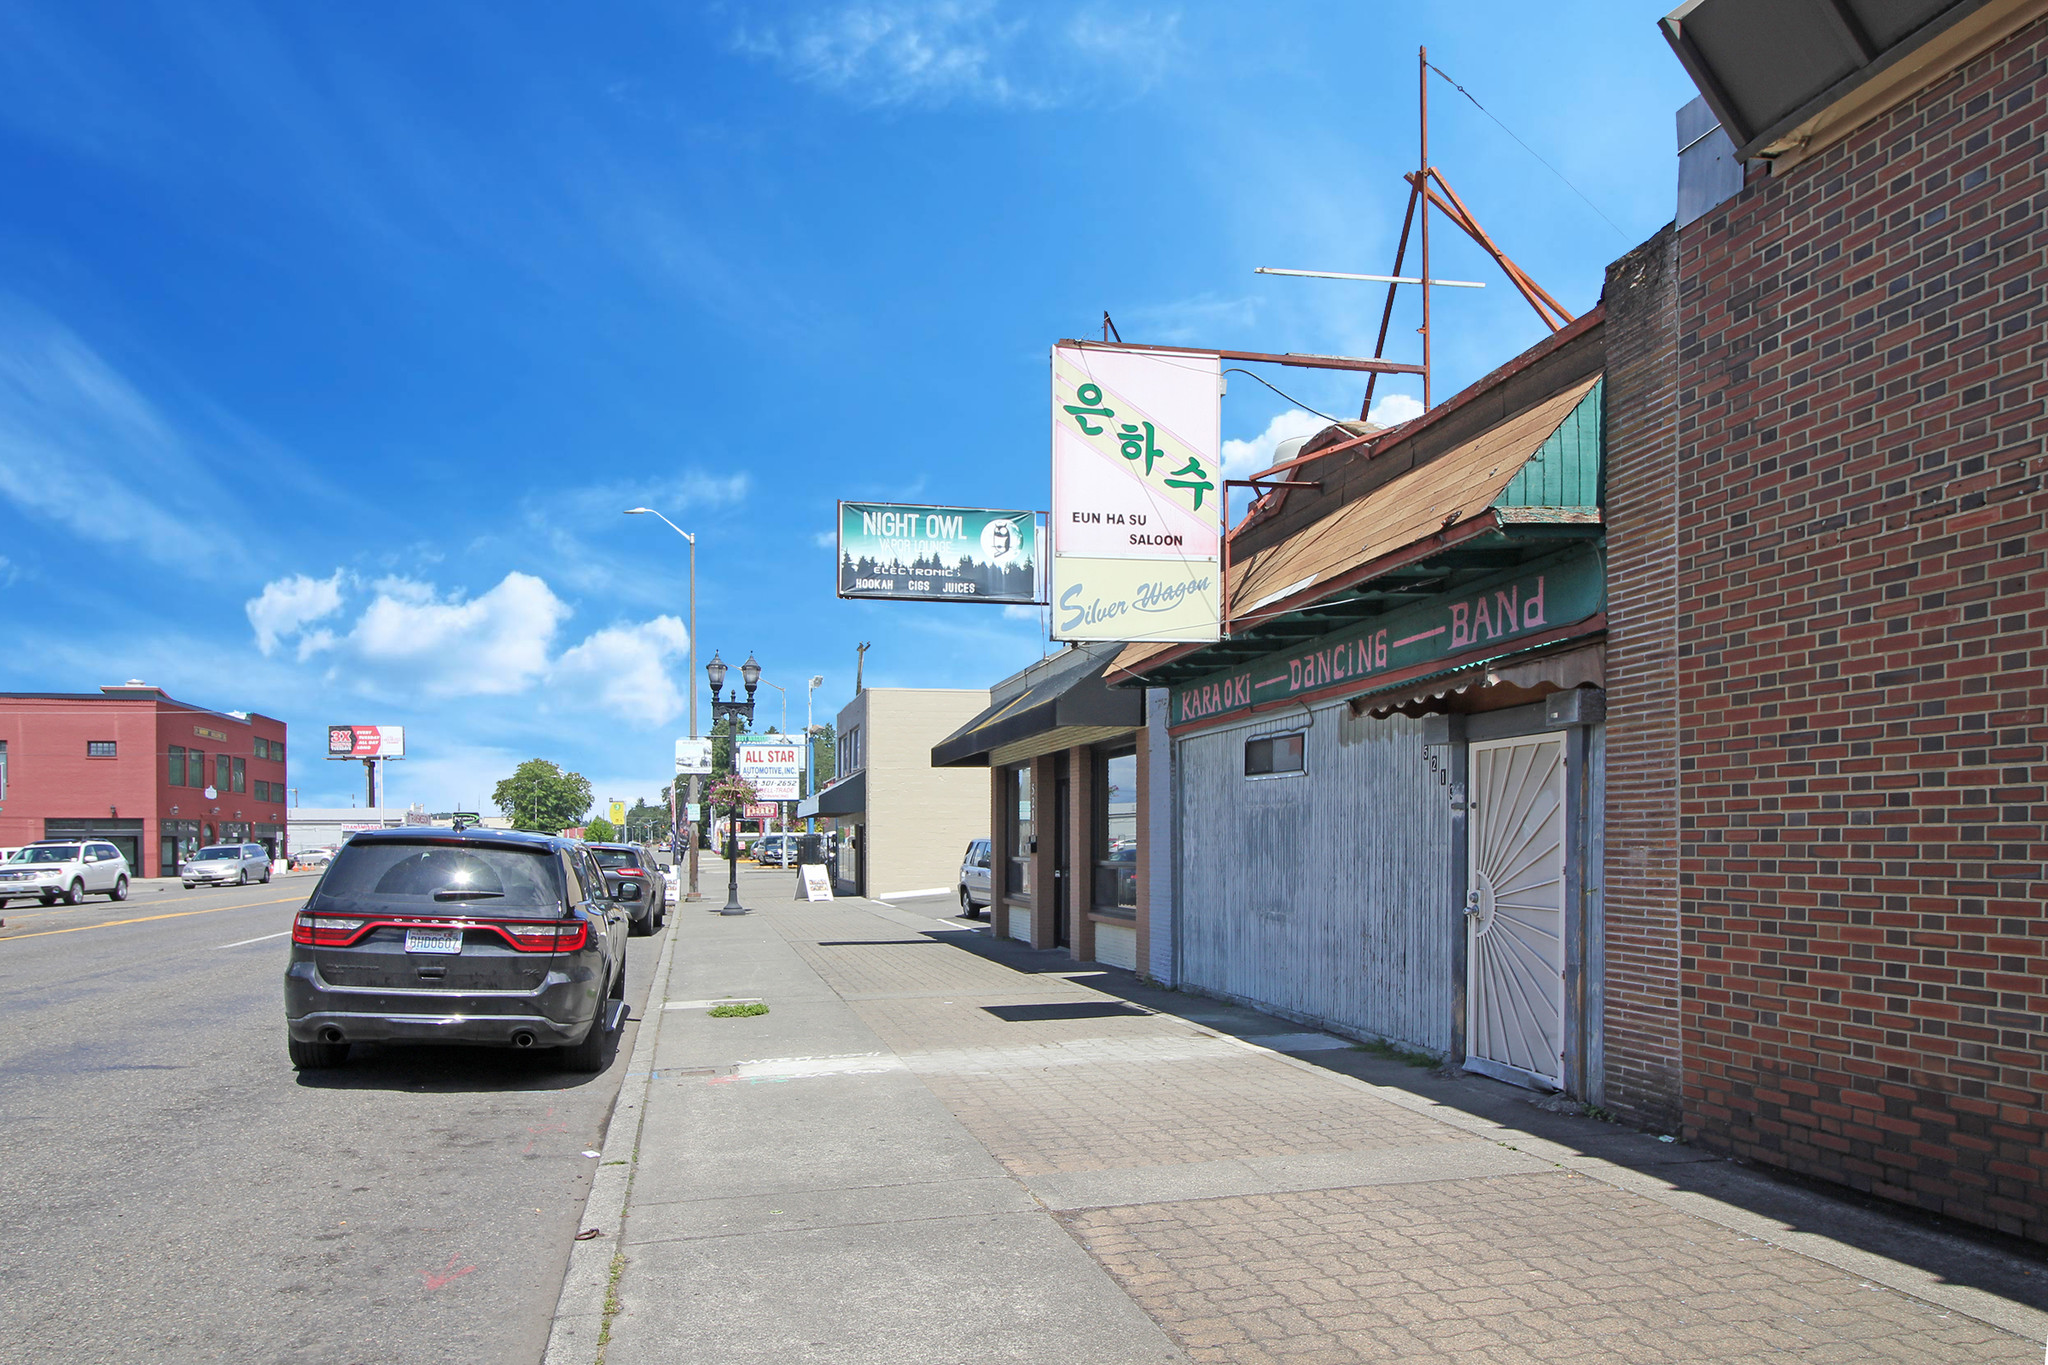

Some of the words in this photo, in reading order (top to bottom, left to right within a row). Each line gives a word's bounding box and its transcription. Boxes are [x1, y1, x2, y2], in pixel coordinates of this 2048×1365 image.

[1063, 383, 1214, 511] 은하수
[863, 511, 919, 538] NIGHT
[926, 514, 967, 540] OWL
[1072, 511, 1101, 525] EUN
[1106, 513, 1125, 526] HA
[1129, 514, 1147, 526] SU
[879, 538, 911, 552] VAPOR
[914, 540, 952, 553] LOUNGE
[1129, 533, 1183, 547] SALOON
[855, 578, 893, 590] HOOKAH
[908, 580, 930, 591] CIGS
[943, 582, 975, 593] JUICES
[1060, 583, 1129, 632] Silver
[1132, 576, 1211, 613] Wagon
[330, 730, 352, 743] 3X
[745, 750, 764, 763] ALL
[768, 750, 795, 763] STAR
